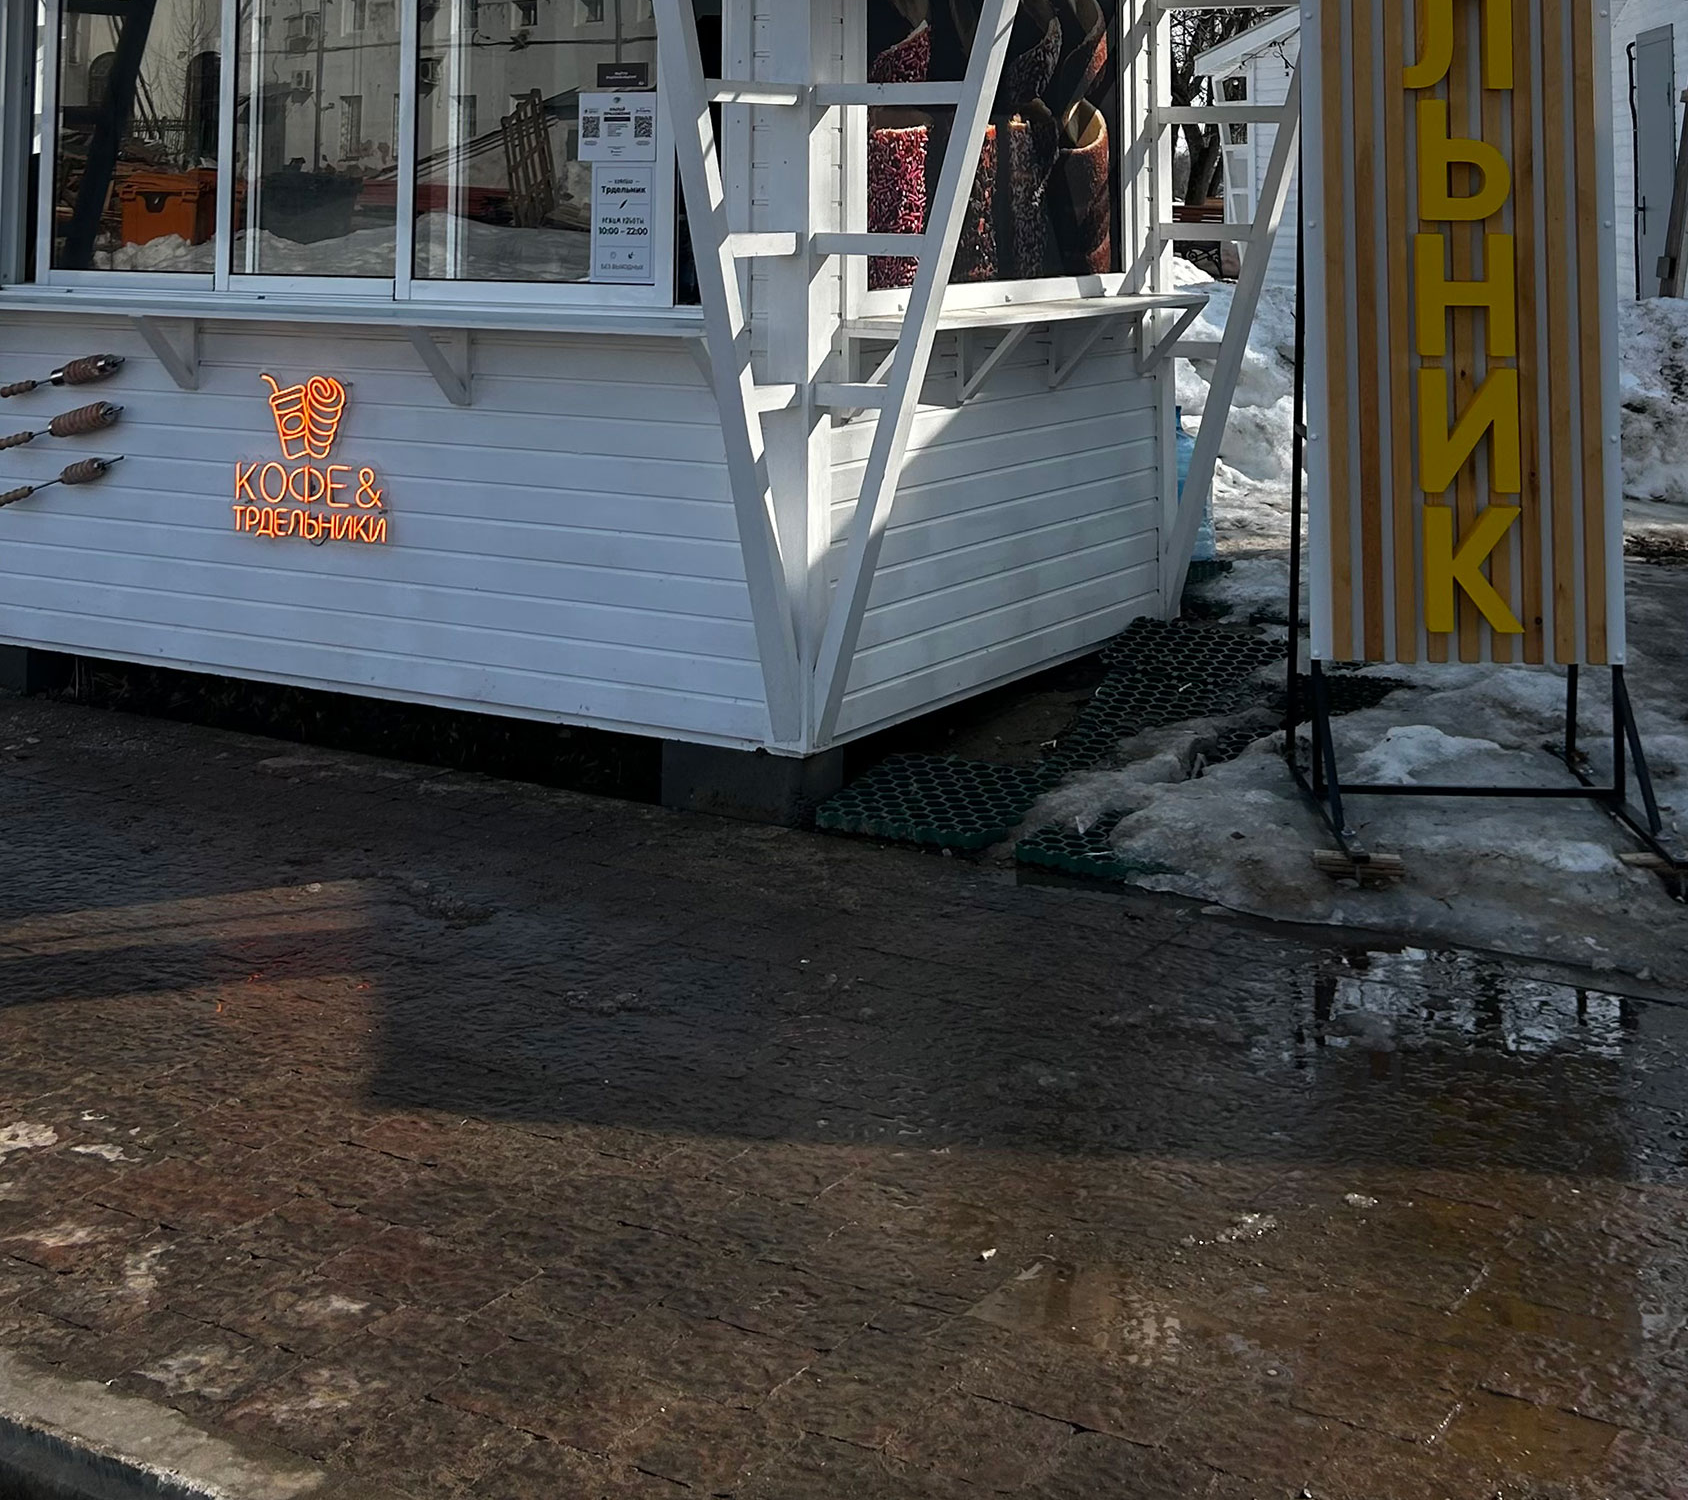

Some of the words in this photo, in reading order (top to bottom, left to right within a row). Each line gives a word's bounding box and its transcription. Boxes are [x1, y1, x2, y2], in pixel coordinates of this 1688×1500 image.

[598, 226, 619, 235] 10:00
[626, 227, 648, 236] 22:00
[232, 504, 387, 544] ТРДЕЛЬНИКИ
